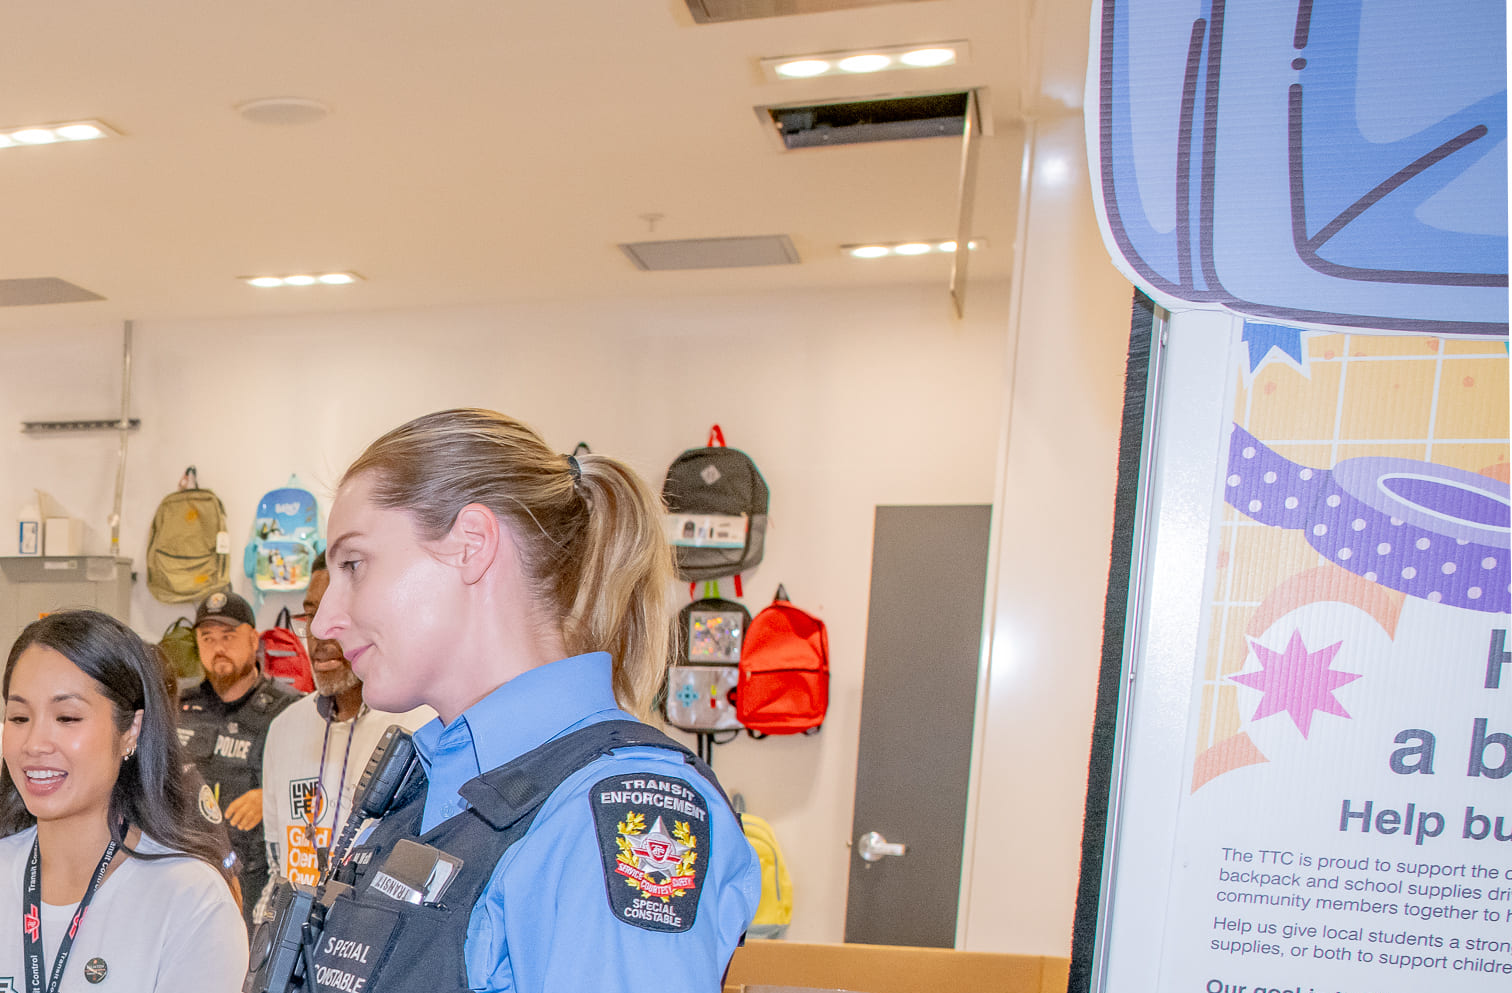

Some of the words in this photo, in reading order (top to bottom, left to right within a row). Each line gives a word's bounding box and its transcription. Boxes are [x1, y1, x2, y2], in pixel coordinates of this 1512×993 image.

[214, 735, 251, 760] POLICE
[1388, 727, 1437, 776] a
[621, 779, 696, 801] TRANSIT
[601, 791, 706, 822] ENFORCEMENT
[1338, 798, 1446, 846] Help
[617, 861, 645, 881] SERVICE
[1221, 847, 1253, 862] The
[1258, 849, 1294, 866] TTC
[1298, 852, 1312, 867] is
[1317, 857, 1369, 871] proud
[1375, 858, 1391, 872] to
[1396, 861, 1466, 879] support
[1471, 864, 1499, 879] the
[28, 865, 38, 893] Transit
[640, 879, 673, 896] COURTESY
[1219, 867, 1301, 887] backpack
[1306, 875, 1339, 889] and
[1344, 877, 1403, 894] school
[1408, 883, 1482, 901] supplies
[624, 906, 682, 928] CONSTABLE
[632, 898, 677, 916] SPECIAL
[1216, 891, 1312, 911] community
[1316, 898, 1398, 915] members
[1404, 902, 1479, 921] together
[1483, 908, 1500, 922] to
[1213, 916, 1252, 935] Help
[1257, 923, 1277, 934] us
[1282, 922, 1317, 939] give
[1322, 925, 1363, 941] local
[1368, 930, 1443, 948] students
[1449, 938, 1460, 949] a
[324, 936, 371, 964] SPECIAL
[1210, 939, 1284, 957] supplies,
[1290, 945, 1309, 957] or
[1313, 944, 1352, 961] both
[1357, 949, 1373, 962] to
[1378, 953, 1448, 970] support
[29, 954, 40, 986] Control
[53, 951, 68, 980] Transit
